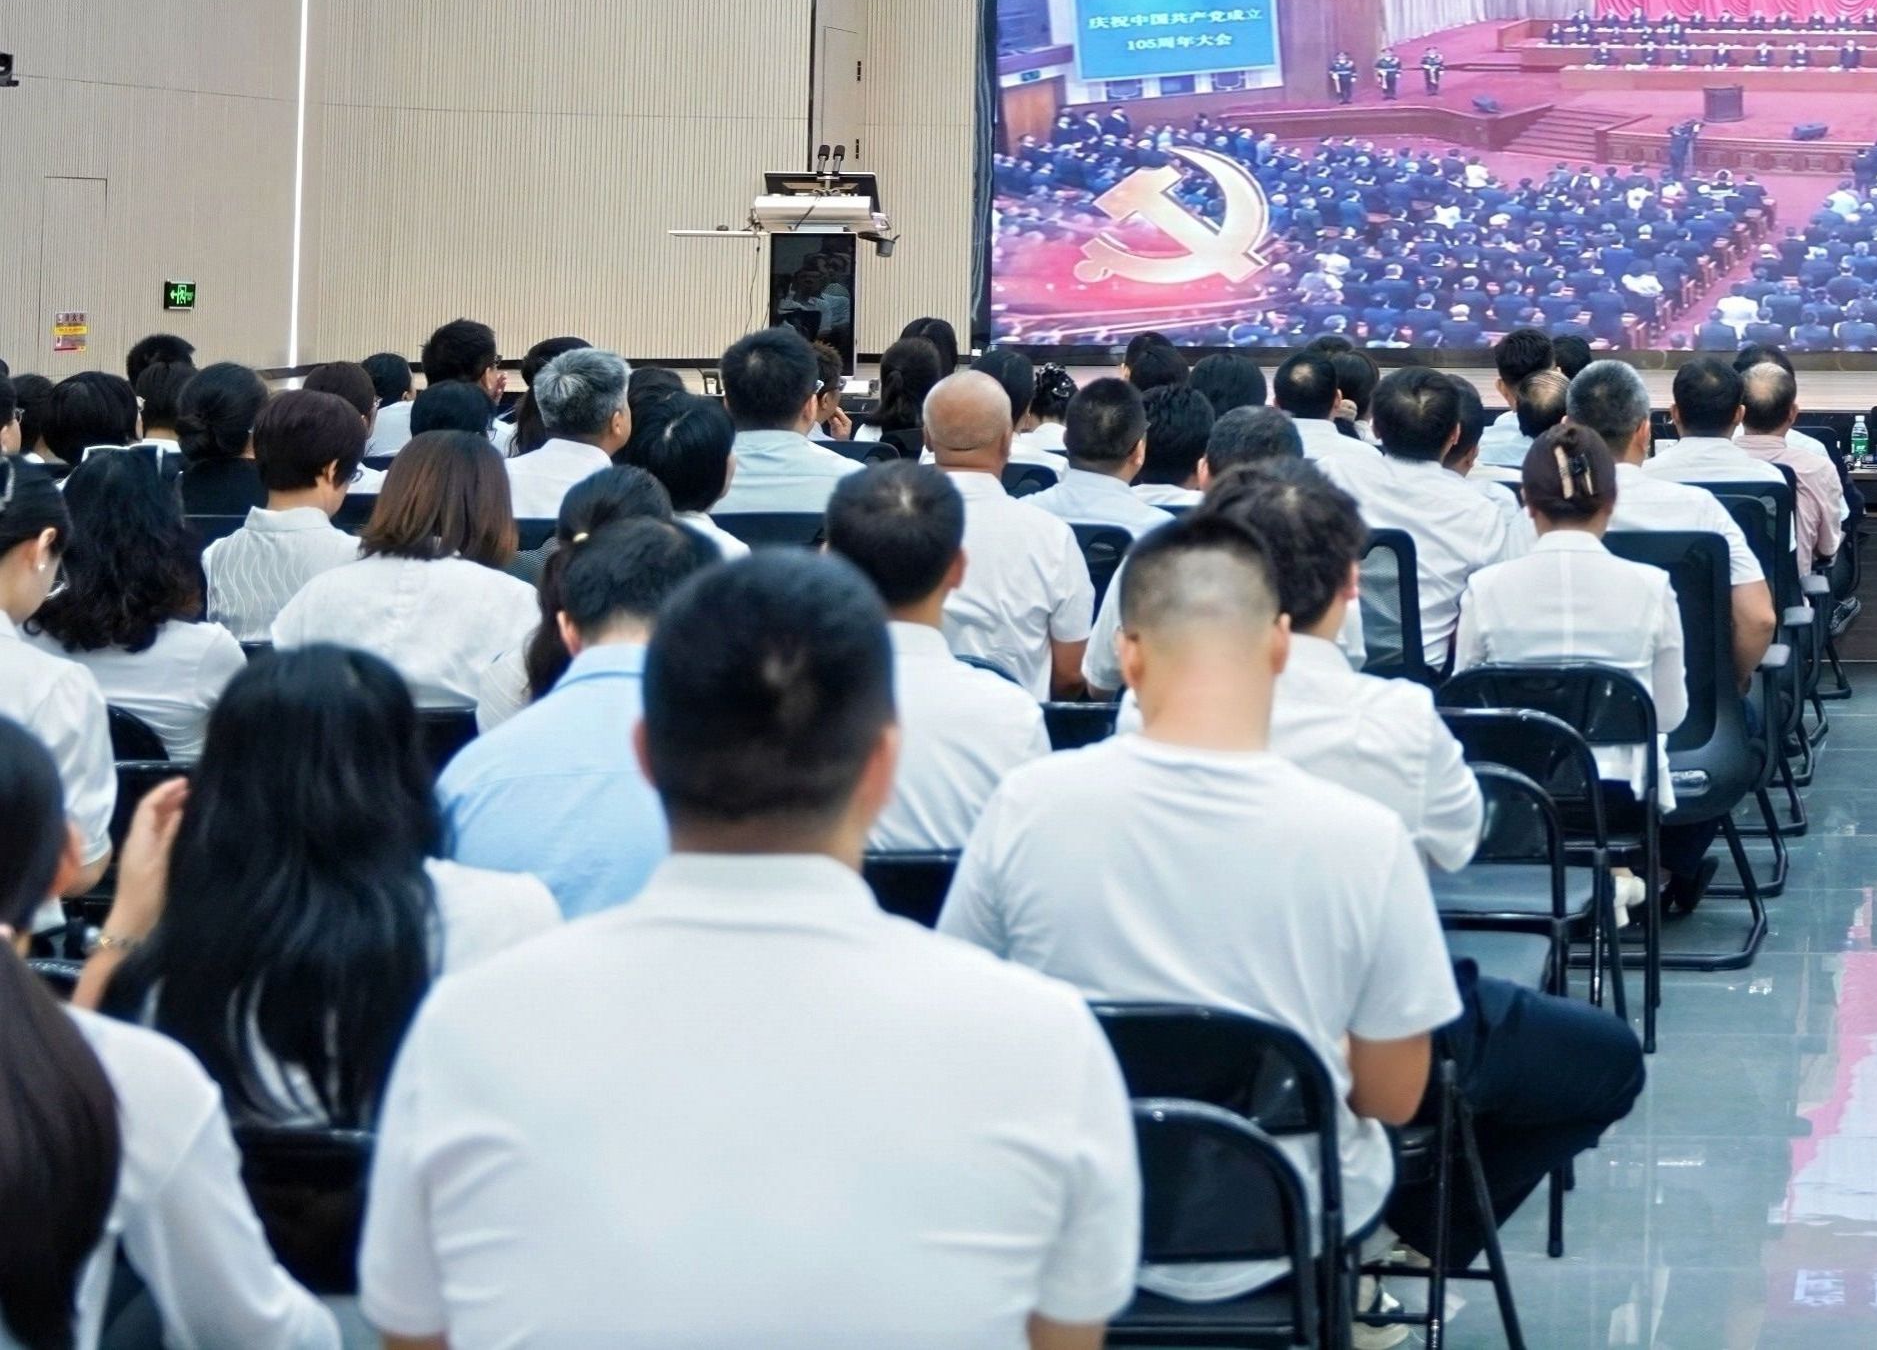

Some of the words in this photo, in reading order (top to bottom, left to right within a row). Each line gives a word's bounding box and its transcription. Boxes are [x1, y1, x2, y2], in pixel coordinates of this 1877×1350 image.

[1088, 8, 1262, 29] 庆祝中国共产党成立
[1127, 32, 1233, 50] 105周年大会
